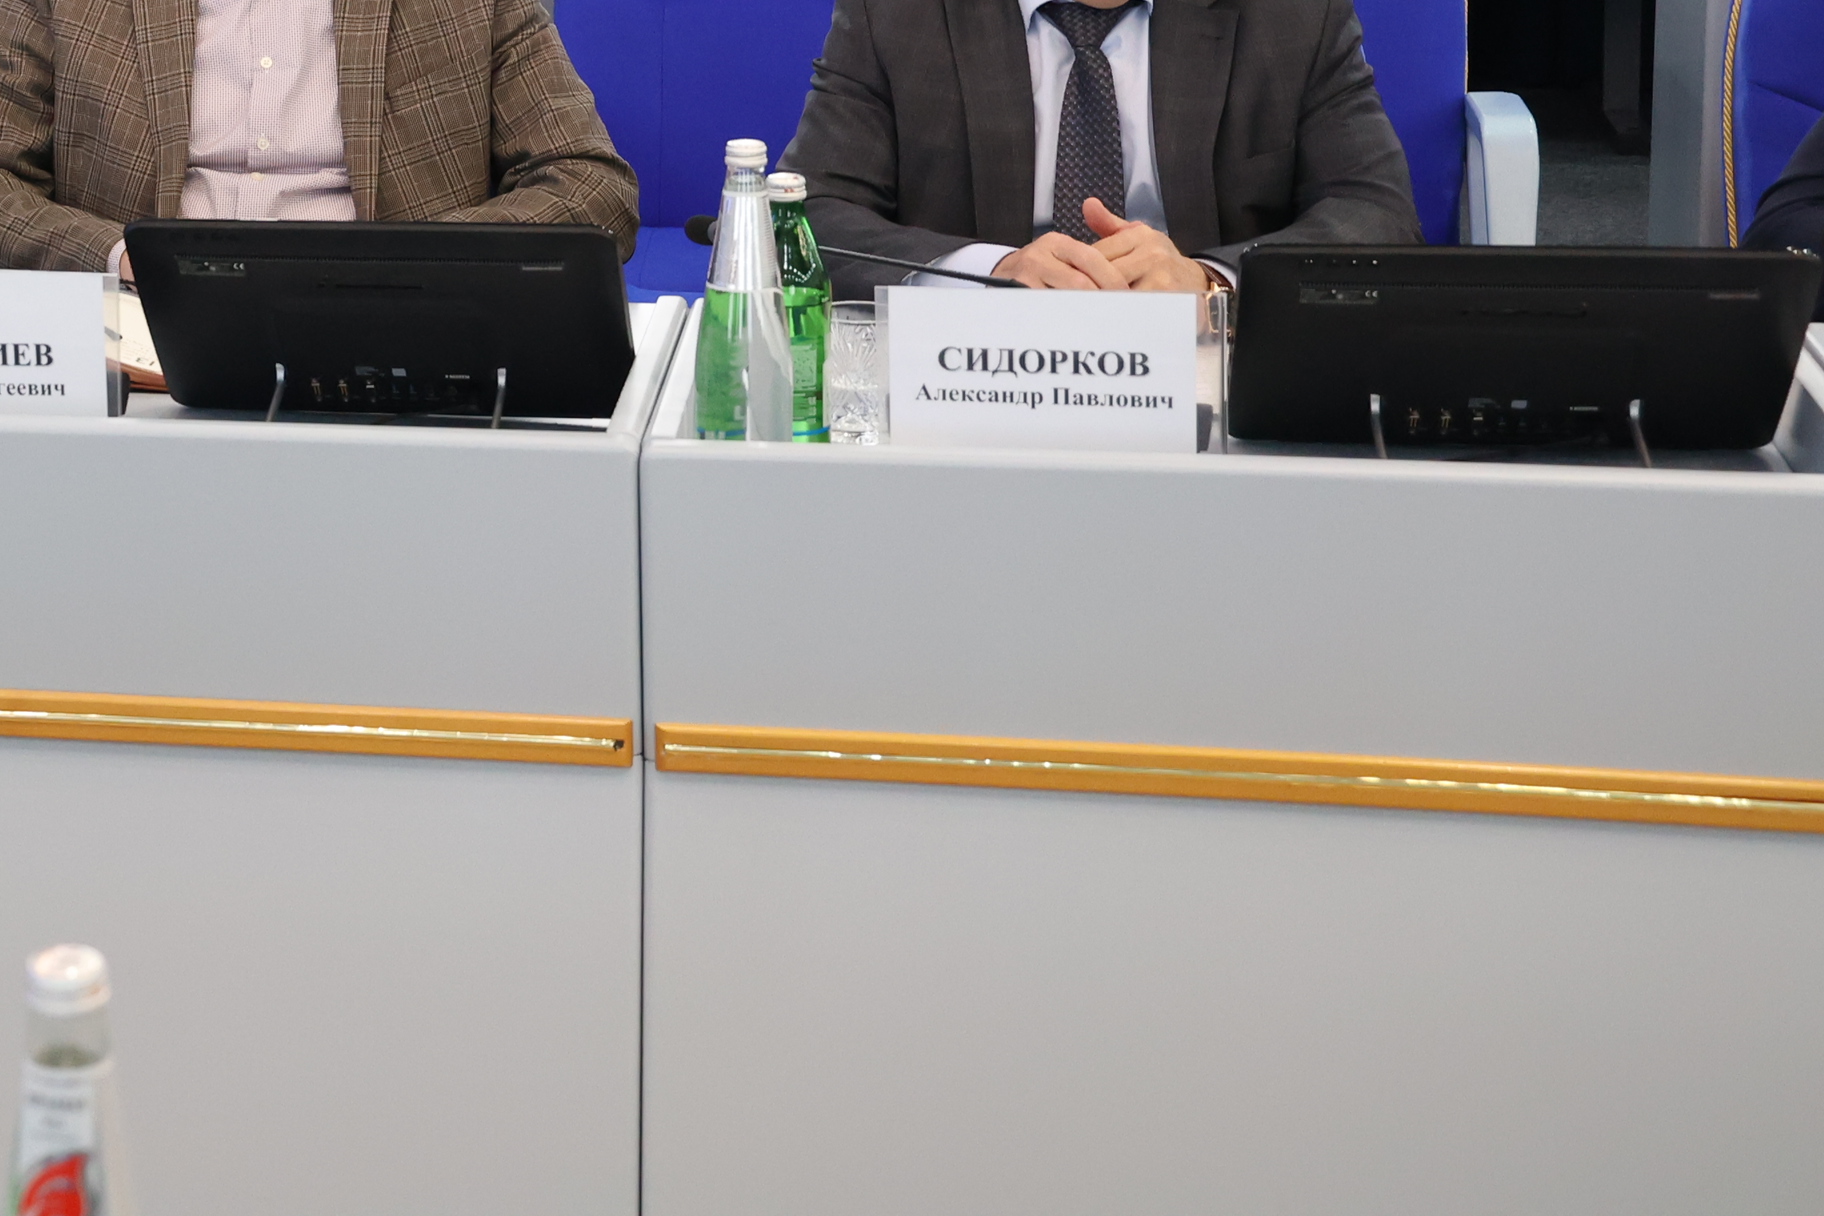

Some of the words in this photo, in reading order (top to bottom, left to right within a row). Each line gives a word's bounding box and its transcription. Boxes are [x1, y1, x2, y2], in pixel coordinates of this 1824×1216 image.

[937, 346, 1151, 378] СИДОРКОВ
[915, 383, 1044, 410] Александр
[1051, 386, 1174, 410] Павлович
